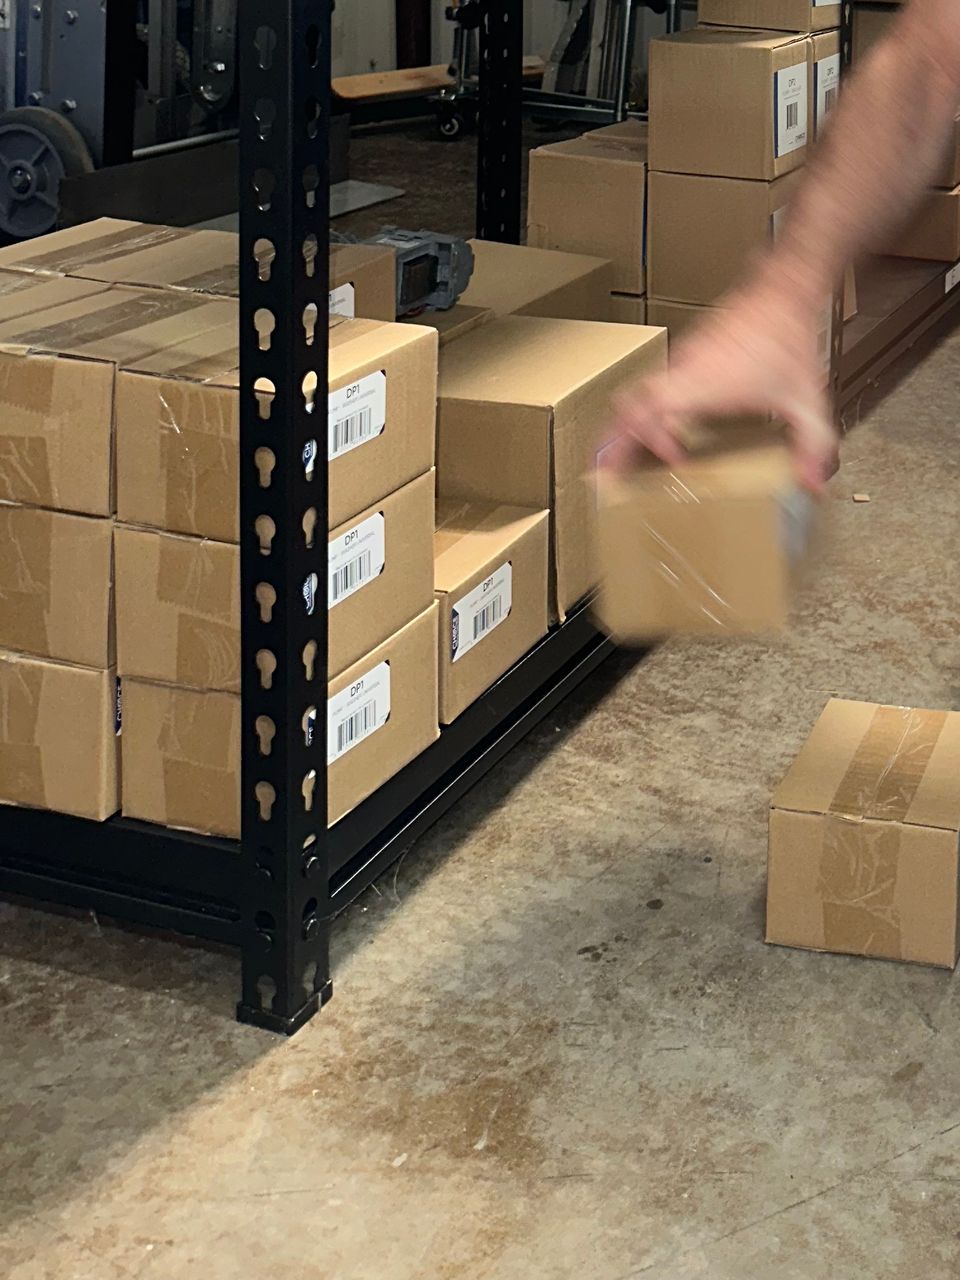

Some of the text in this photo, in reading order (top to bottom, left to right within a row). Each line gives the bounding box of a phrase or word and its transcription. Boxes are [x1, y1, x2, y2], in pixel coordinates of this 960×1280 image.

[346, 384, 360, 399] DP1
[344, 529, 359, 546] DP1
[482, 576, 495, 593] DP1
[350, 680, 365, 698] DP1
